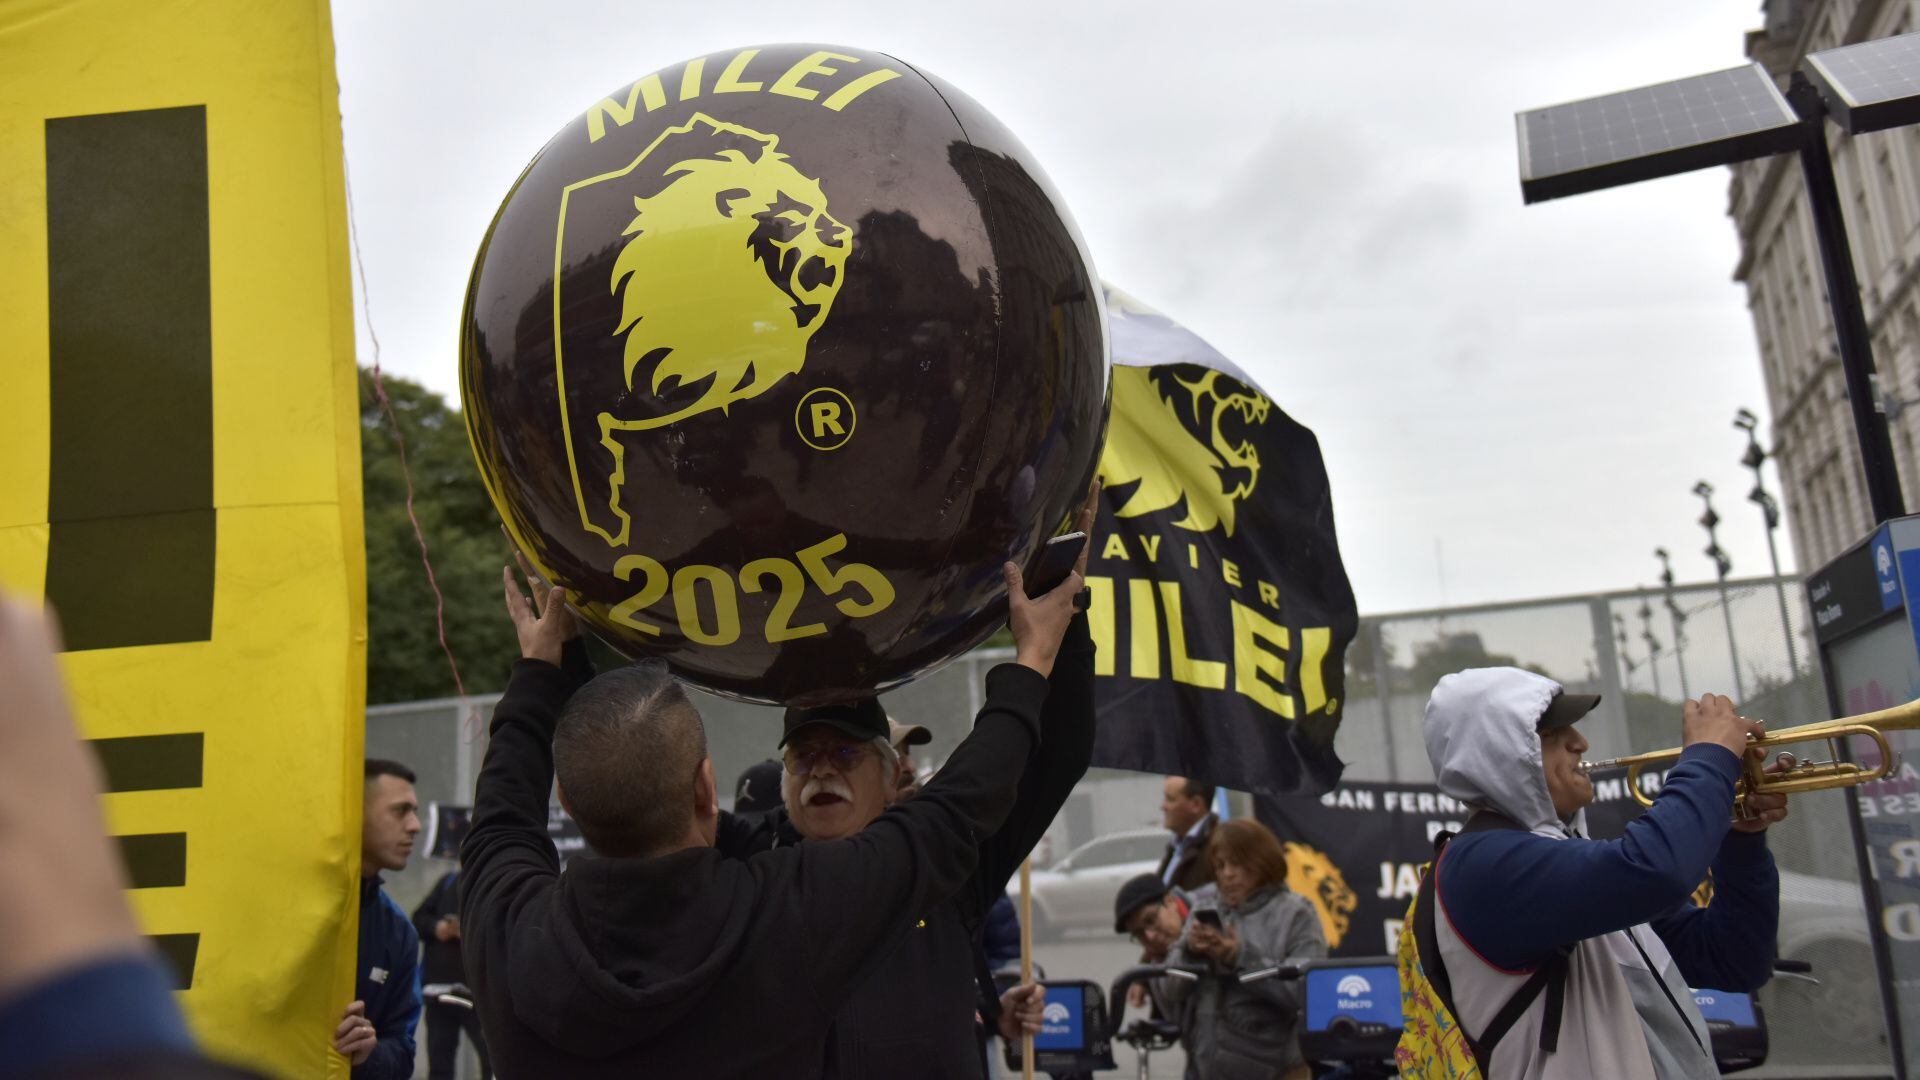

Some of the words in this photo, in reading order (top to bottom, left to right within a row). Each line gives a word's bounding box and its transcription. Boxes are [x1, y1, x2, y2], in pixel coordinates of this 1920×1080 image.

[585, 49, 901, 143] MILEI
[608, 533, 896, 645] 2025
[1319, 788, 1376, 811] SAN
[1382, 790, 1470, 814] FERN
[1376, 861, 1422, 899] JA
[1337, 998, 1373, 1010] Macro
